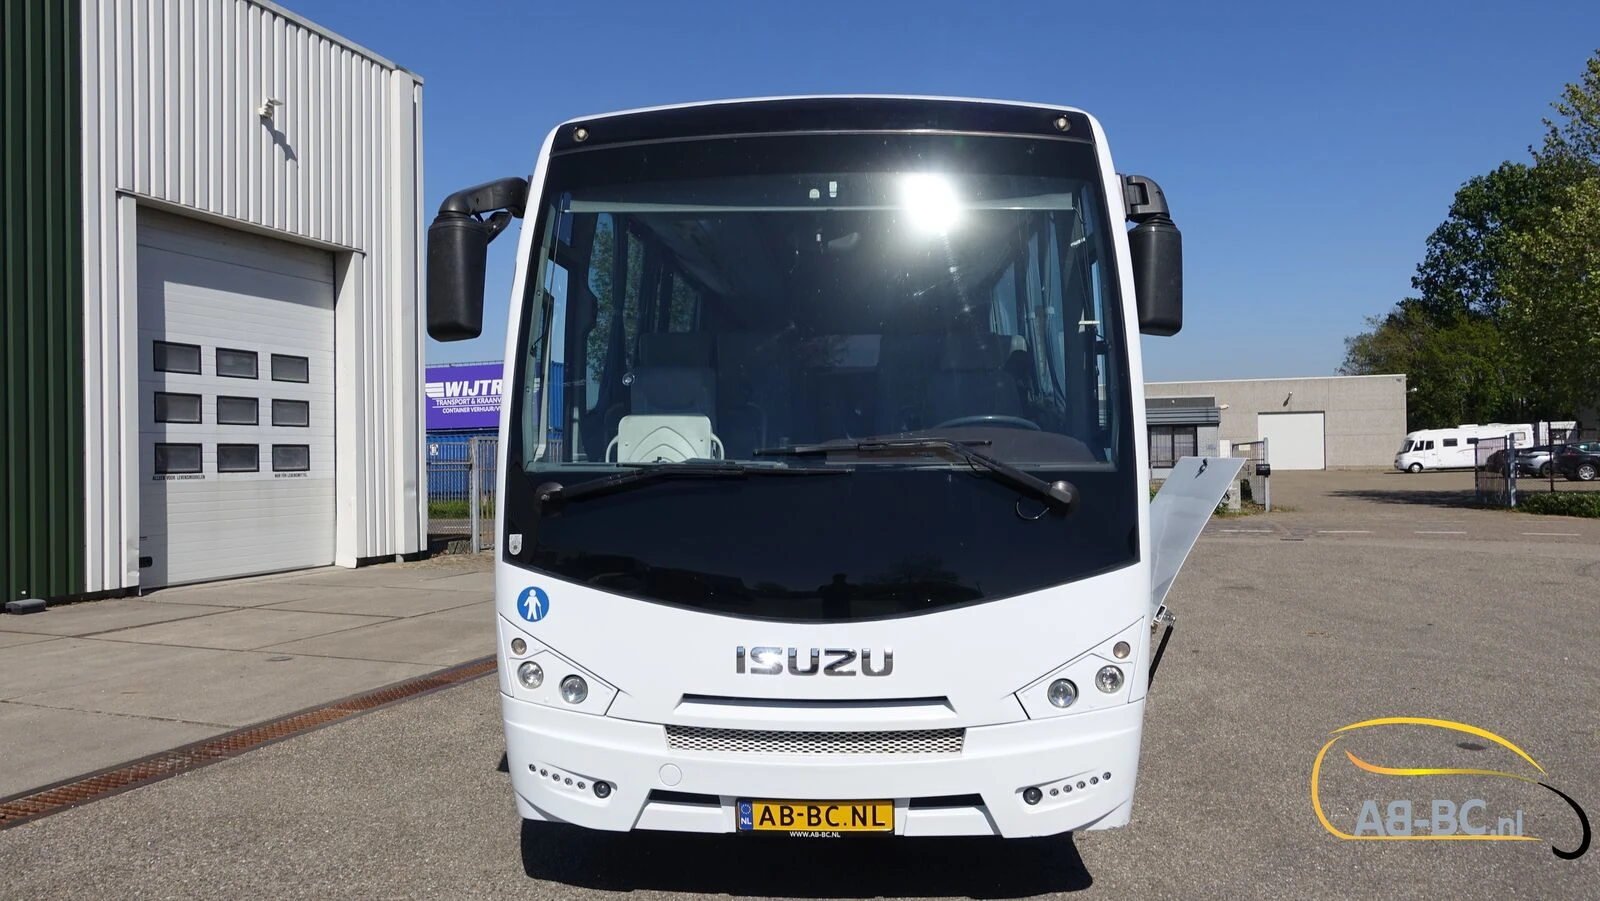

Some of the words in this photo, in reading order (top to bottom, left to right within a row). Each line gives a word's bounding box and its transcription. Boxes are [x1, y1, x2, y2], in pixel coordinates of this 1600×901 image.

[436, 398, 470, 406] TRANSPORT
[442, 406, 470, 414] CONTAINER
[736, 645, 893, 677] ISUZU
[758, 805, 886, 827] AB-BC.NL
[740, 817, 752, 825] NL
